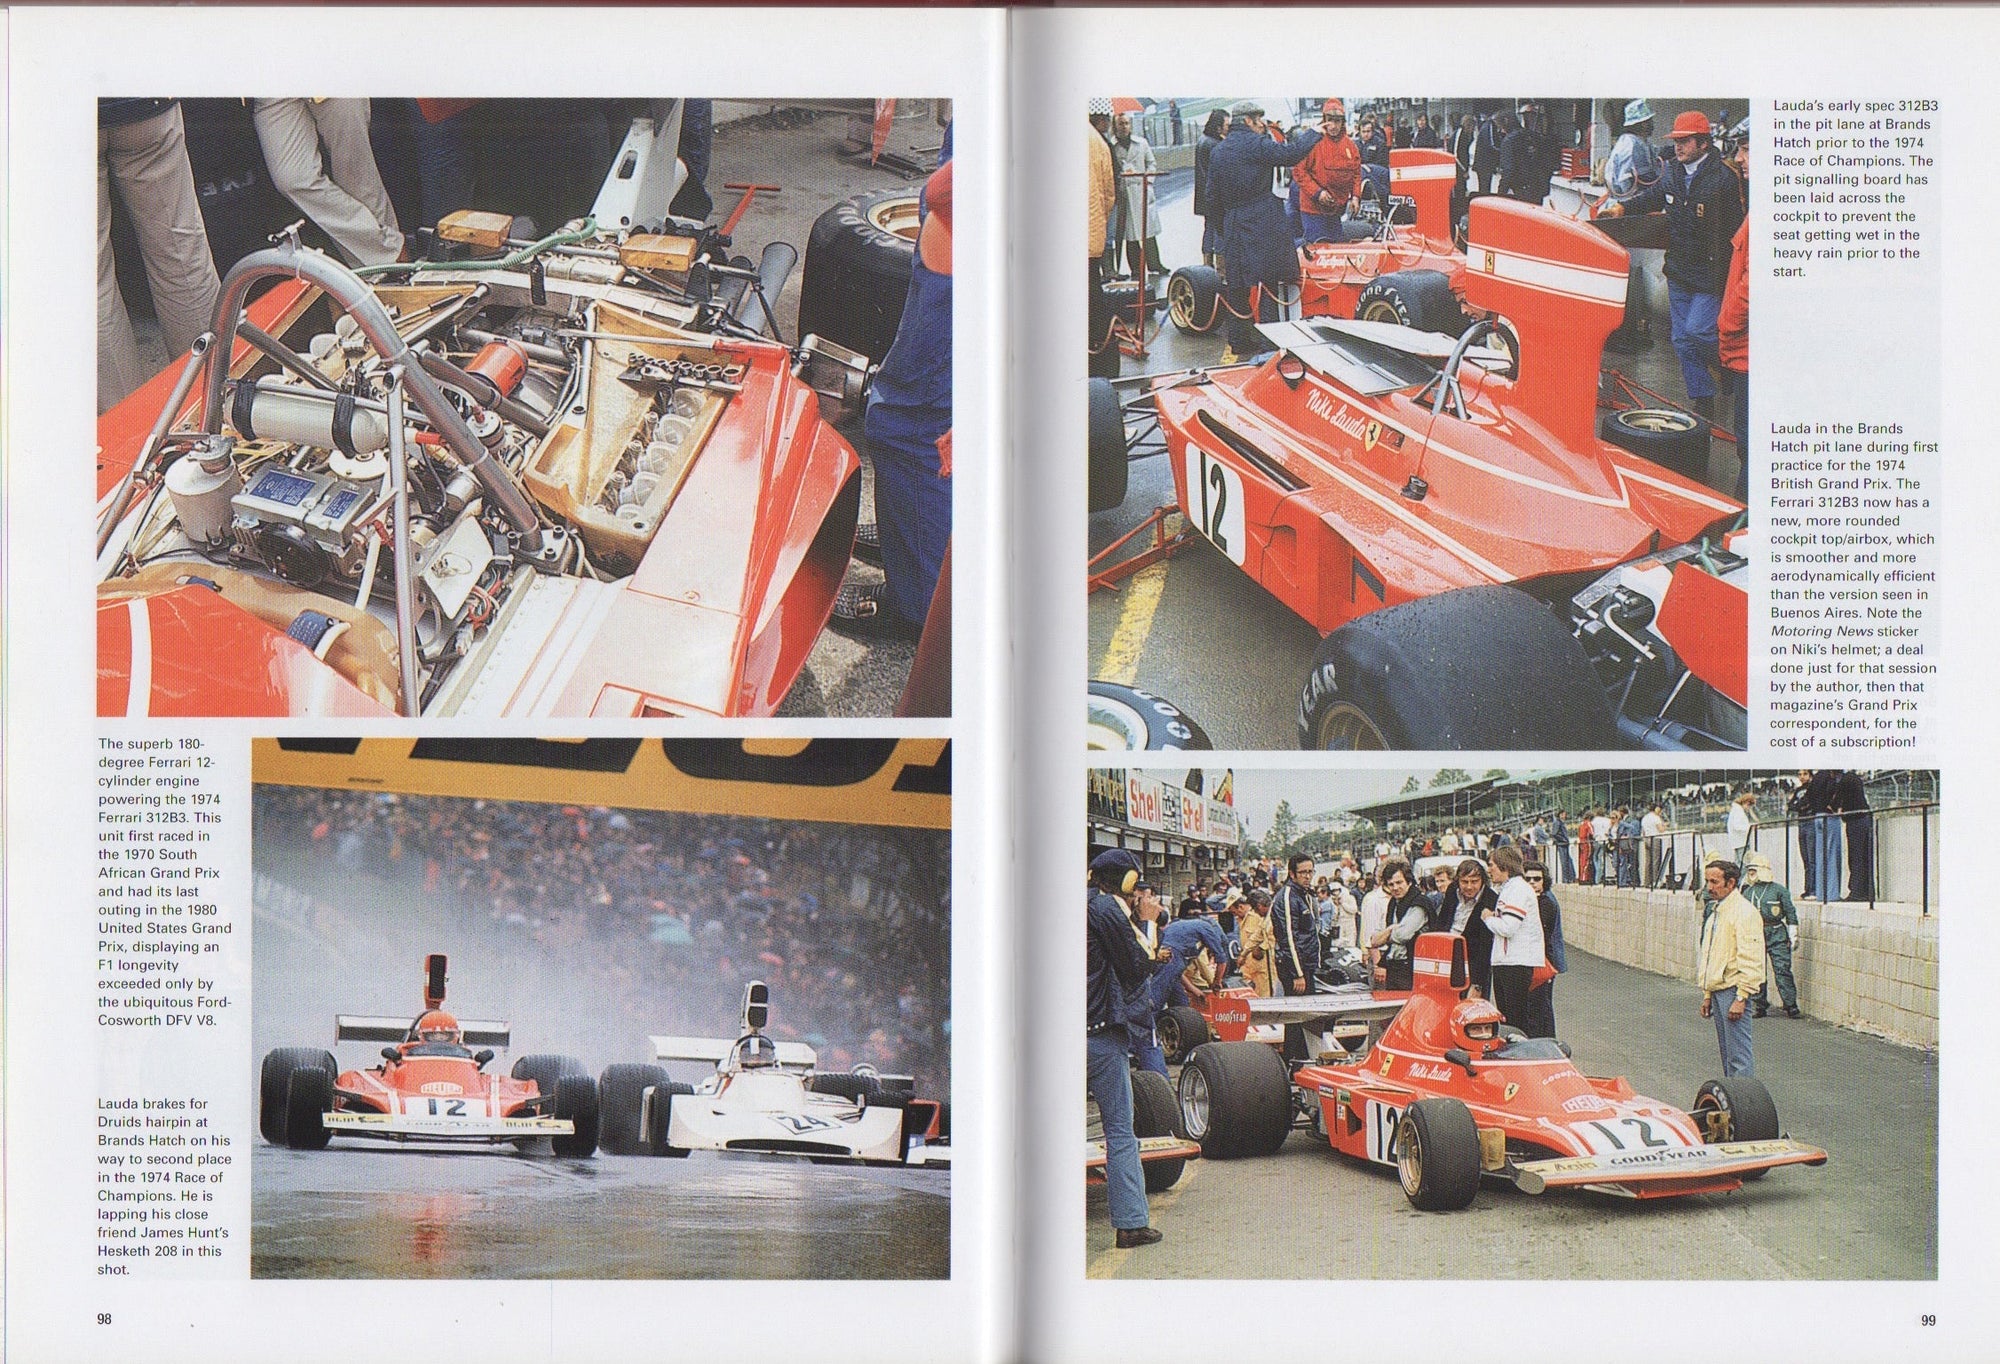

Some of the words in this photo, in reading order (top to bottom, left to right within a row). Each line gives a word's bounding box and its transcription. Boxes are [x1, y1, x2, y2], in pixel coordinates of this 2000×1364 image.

[1774, 99, 1823, 111] Lauda's
[1828, 99, 1860, 113] early
[1865, 102, 1894, 113] spec
[1898, 99, 1938, 111] 312B3
[1773, 136, 1810, 148] Hatch
[1816, 136, 1848, 150] prior
[1851, 138, 1864, 148] to
[1869, 136, 1889, 148] the
[1895, 136, 1924, 148] 1974
[1773, 154, 1805, 166] Race
[1809, 154, 1823, 166] of
[1827, 154, 1904, 168] Champions.
[1908, 154, 1933, 166] The
[1773, 173, 1790, 187] pit
[1794, 173, 1858, 187] signalling
[1863, 173, 1900, 184] board
[1906, 173, 1928, 185] has
[1773, 191, 1805, 203] been
[1810, 191, 1833, 203] laid
[1838, 194, 1880, 203] across
[1884, 191, 1905, 203] the
[1773, 210, 1819, 224] cockpit
[1823, 211, 1837, 221] to
[1842, 211, 1891, 224] prevent
[1895, 210, 1915, 221] the
[1773, 266, 1805, 276] start.
[1306, 388, 1333, 421] Niki
[1329, 403, 1367, 441] Lauda
[1771, 422, 1810, 433] Lauda
[1815, 422, 1827, 433] in
[1831, 422, 1853, 433] the
[1858, 422, 1903, 434] Brands
[1771, 440, 1808, 452] Hatch
[1813, 440, 1830, 454] pit
[1835, 440, 1862, 452] lane
[1866, 440, 1908, 455] during
[1912, 440, 1938, 452] first
[1771, 459, 1822, 473] practice
[1826, 458, 1846, 470] for
[1849, 459, 1870, 471] the
[1876, 459, 1905, 470] 1974
[1771, 477, 1812, 489] British
[1817, 477, 1858, 489] Grand
[1863, 477, 1891, 489] Prix.
[1895, 477, 1920, 489] The
[1200, 450, 1228, 553] 12
[1771, 517, 1801, 527] new,
[1806, 517, 1840, 526] more
[1845, 514, 1899, 526] rounded
[1770, 532, 1816, 546] cockpit
[1821, 533, 1891, 546] top/airbox,
[1896, 533, 1934, 544] which
[1770, 569, 1879, 583] aerodynamically
[1883, 569, 1935, 581] efficient
[1771, 606, 1820, 618] Buenos
[1824, 606, 1861, 618] Aires.
[1867, 607, 1897, 618] Note
[1902, 607, 1922, 618] the
[1771, 625, 1832, 639] Motoring
[1836, 625, 1873, 636] News
[1877, 625, 1919, 636] sticker
[1770, 680, 1786, 694] by
[1790, 680, 1811, 692] the
[1815, 680, 1861, 693] author,
[1866, 680, 1894, 692] then
[1899, 680, 1924, 692] that
[1770, 698, 1843, 713] magazine's
[1848, 698, 1888, 710] Grand
[1892, 698, 1917, 710] Prix
[1769, 717, 1869, 730] correspondent,
[1874, 717, 1892, 728] for
[1896, 717, 1916, 728] the
[98, 737, 123, 749] The
[127, 737, 173, 751] superb
[178, 738, 204, 749] 180-
[98, 756, 144, 770] degree
[149, 756, 190, 767] Ferrari
[196, 756, 215, 767] 12-
[98, 774, 151, 788] cylinder
[155, 774, 199, 788] engine
[98, 793, 160, 807] powering
[164, 793, 185, 804] the
[191, 793, 220, 804] 1974
[1130, 777, 1162, 823] Shell
[98, 811, 141, 823] Ferrari
[146, 811, 189, 823] 312B3.
[193, 811, 221, 823] This
[98, 848, 119, 859] the
[124, 848, 154, 859] 1970
[159, 848, 197, 860] South
[98, 866, 145, 878] African
[150, 866, 189, 878] Grand
[195, 866, 219, 878] Prix
[98, 903, 140, 917] outing
[145, 903, 157, 915] in
[161, 904, 182, 915] the
[187, 904, 217, 915] 1980
[98, 922, 142, 933] United
[146, 921, 187, 933] States
[191, 921, 231, 933] Grand
[98, 940, 127, 953] Prix,
[132, 940, 198, 954] displaying
[203, 943, 219, 952] an
[98, 996, 118, 1007] the
[123, 995, 193, 1009] ubiquitous
[197, 996, 231, 1007] Ford-
[98, 1013, 161, 1025] Cosworth
[166, 1014, 192, 1025] DFV
[196, 1014, 216, 1025] V8.
[98, 1097, 138, 1109] Lauda
[143, 1097, 185, 1109] brakes
[189, 1097, 208, 1109] for
[428, 1098, 467, 1117] 12
[98, 1115, 141, 1127] Druids
[145, 1115, 190, 1129] hairpin
[195, 1117, 207, 1127] at
[777, 1114, 830, 1131] 24
[1375, 1102, 1399, 1163] 12
[1589, 1118, 1668, 1149] 12
[98, 1134, 144, 1145] Brands
[149, 1134, 185, 1146] Hatch
[190, 1137, 206, 1146] on
[211, 1134, 230, 1146] his
[97, 1155, 124, 1166] way
[129, 1154, 142, 1164] to
[146, 1152, 192, 1164] second
[197, 1153, 231, 1166] place
[97, 1207, 147, 1222] lapping
[151, 1207, 170, 1219] his
[174, 1208, 208, 1219] close
[97, 1226, 136, 1237] friend
[140, 1226, 183, 1238] James
[188, 1226, 228, 1238] Hunt's
[97, 1263, 129, 1275] shot.
[97, 1312, 111, 1324] 98
[1921, 1314, 1936, 1326] 99
